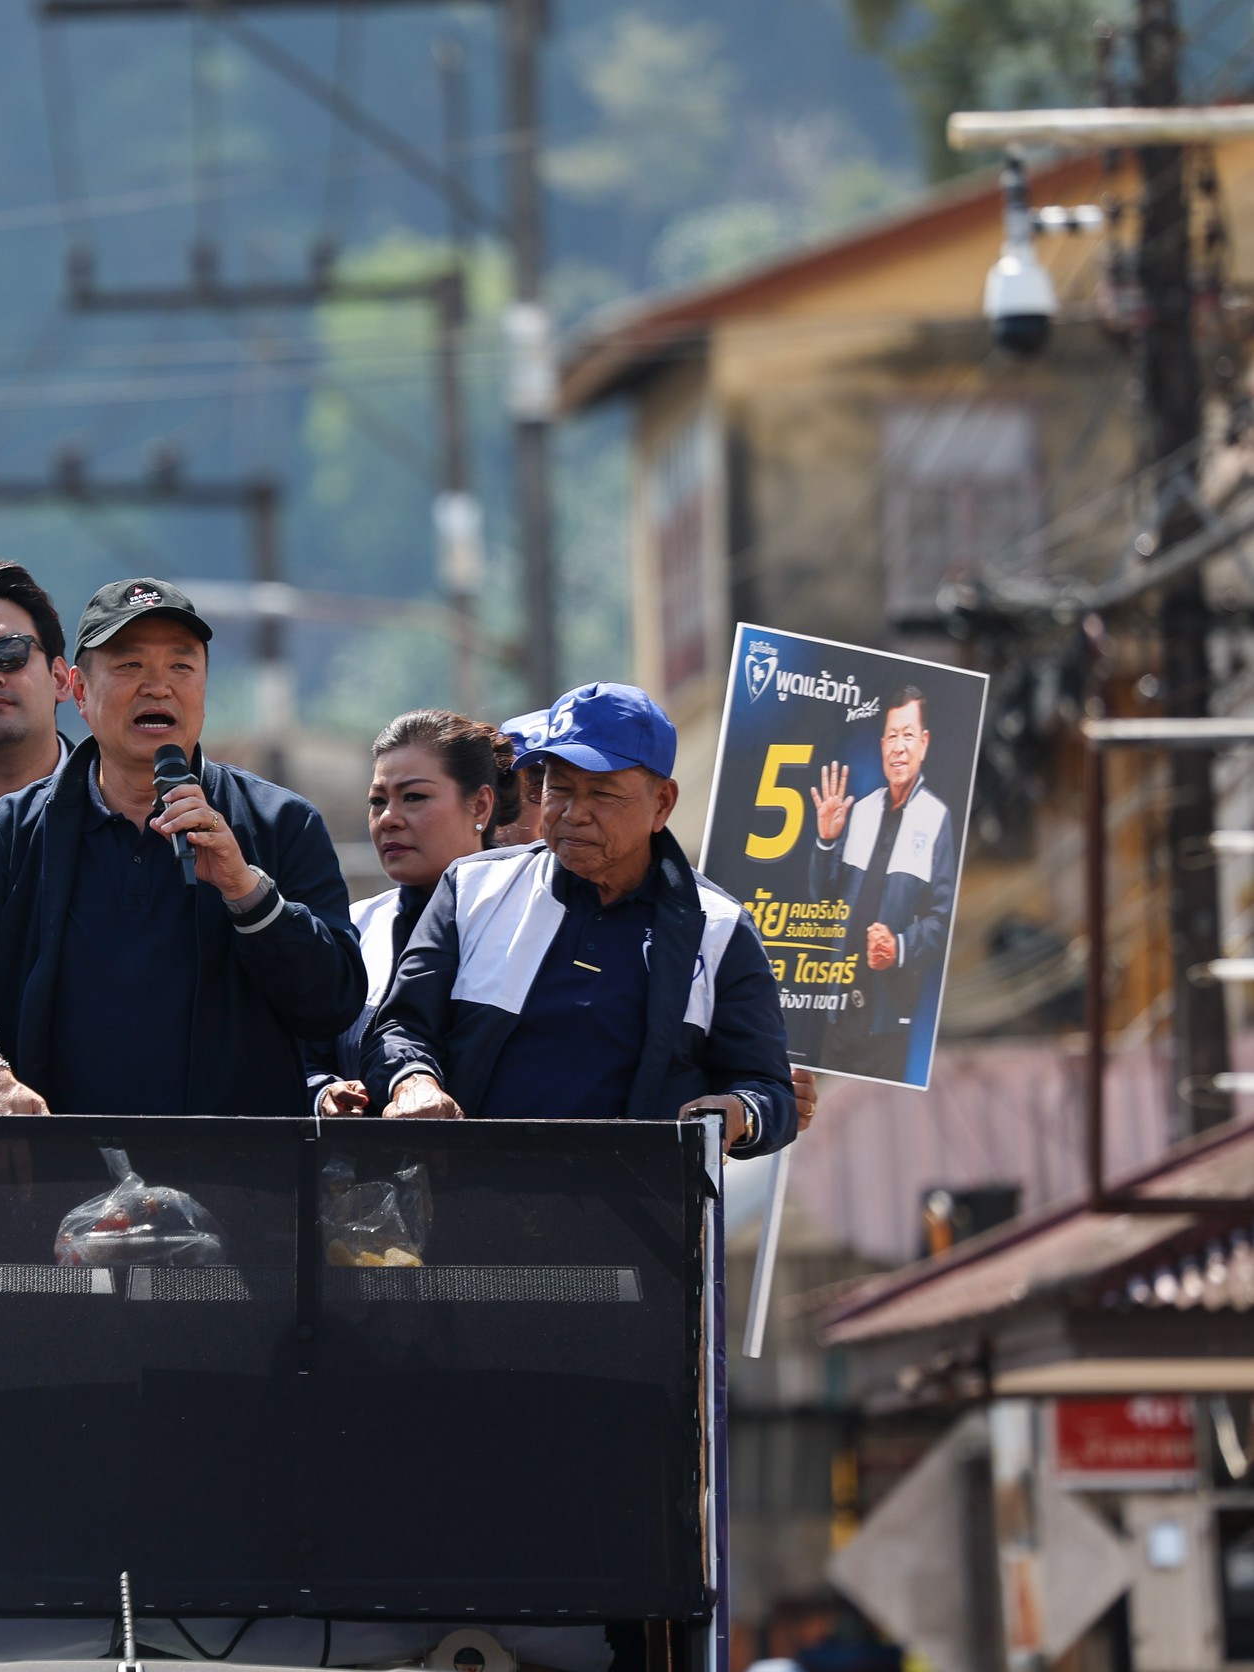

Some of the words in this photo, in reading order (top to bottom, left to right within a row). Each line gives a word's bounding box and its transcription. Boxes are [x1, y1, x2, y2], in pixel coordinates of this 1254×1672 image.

[776, 670, 861, 707] พูดแล้วทำ
[521, 715, 550, 750] 5
[548, 697, 576, 739] 5
[744, 744, 815, 860] 5
[789, 898, 851, 920] คนจริงใจ
[794, 952, 859, 984] ไตรศรี
[812, 994, 839, 1010] เขต
[840, 993, 848, 1011] 1
